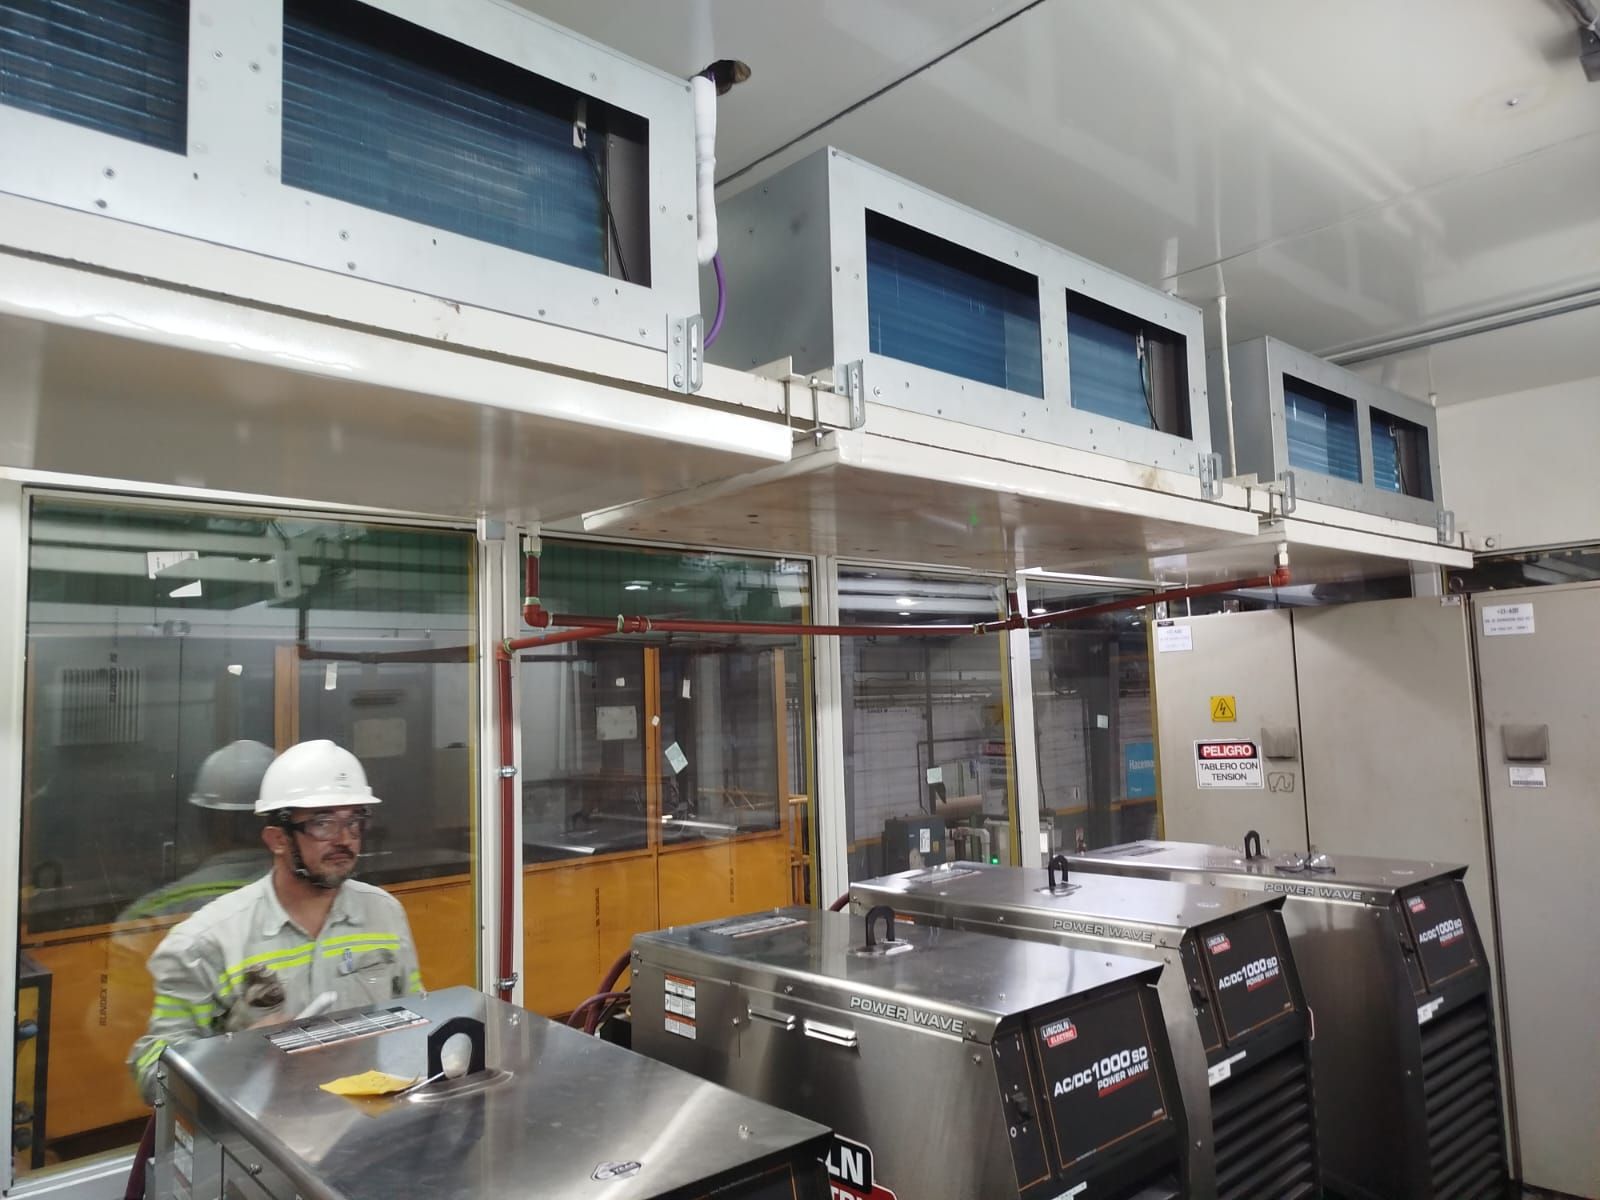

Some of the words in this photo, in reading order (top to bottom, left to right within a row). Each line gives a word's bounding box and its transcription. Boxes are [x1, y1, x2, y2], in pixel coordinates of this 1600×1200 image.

[1202, 744, 1252, 757] PELIGRO
[1200, 762, 1238, 771] TABLERO
[1239, 761, 1258, 770] CON
[1211, 772, 1247, 781] TENSION
[1264, 882, 1315, 896] POWER
[1320, 888, 1362, 900] WAVE
[1053, 919, 1105, 936] POWER
[1109, 925, 1153, 943] WAVE
[850, 996, 908, 1020] POWER
[913, 1009, 964, 1033] WAVE
[1042, 1020, 1070, 1038] LINCOLN
[1049, 1029, 1075, 1045] ELECTRIC
[1131, 1046, 1148, 1063] SD
[1097, 1070, 1126, 1091] POWER
[1126, 1060, 1150, 1077] WAVE
